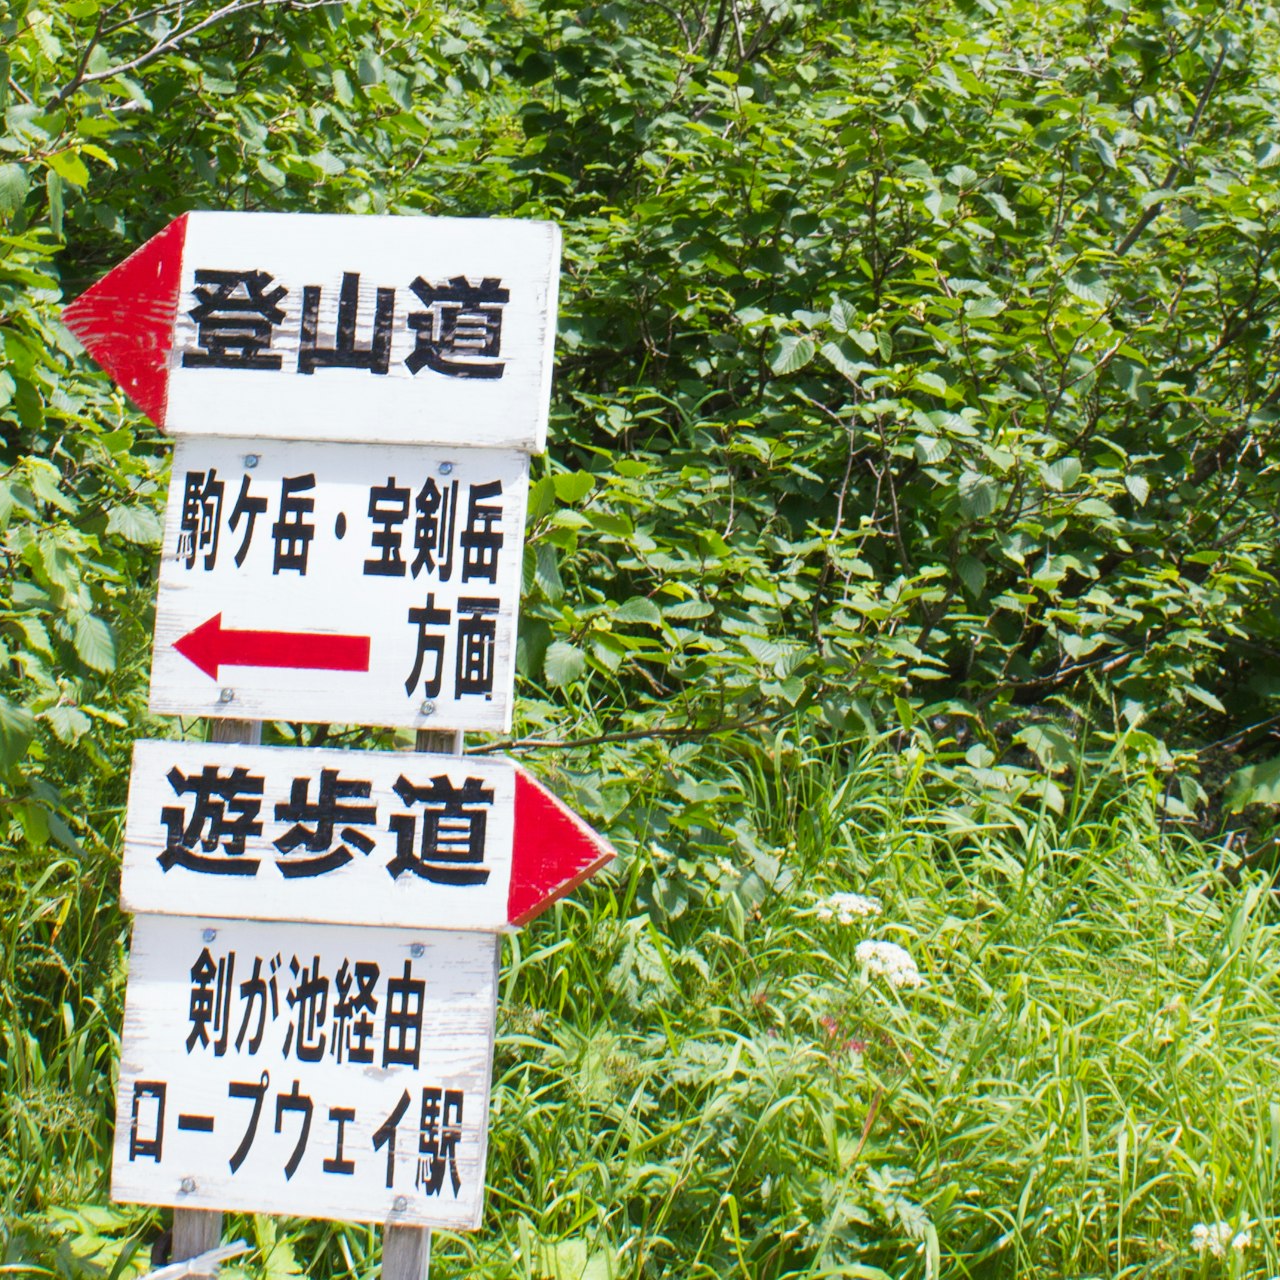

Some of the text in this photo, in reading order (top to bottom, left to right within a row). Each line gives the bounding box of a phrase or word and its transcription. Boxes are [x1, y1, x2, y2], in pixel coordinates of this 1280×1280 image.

[182, 269, 510, 379] 登山道
[405, 592, 501, 701] 方面
[157, 765, 494, 886] 遊歩道
[186, 947, 426, 1070] 剣が池経由
